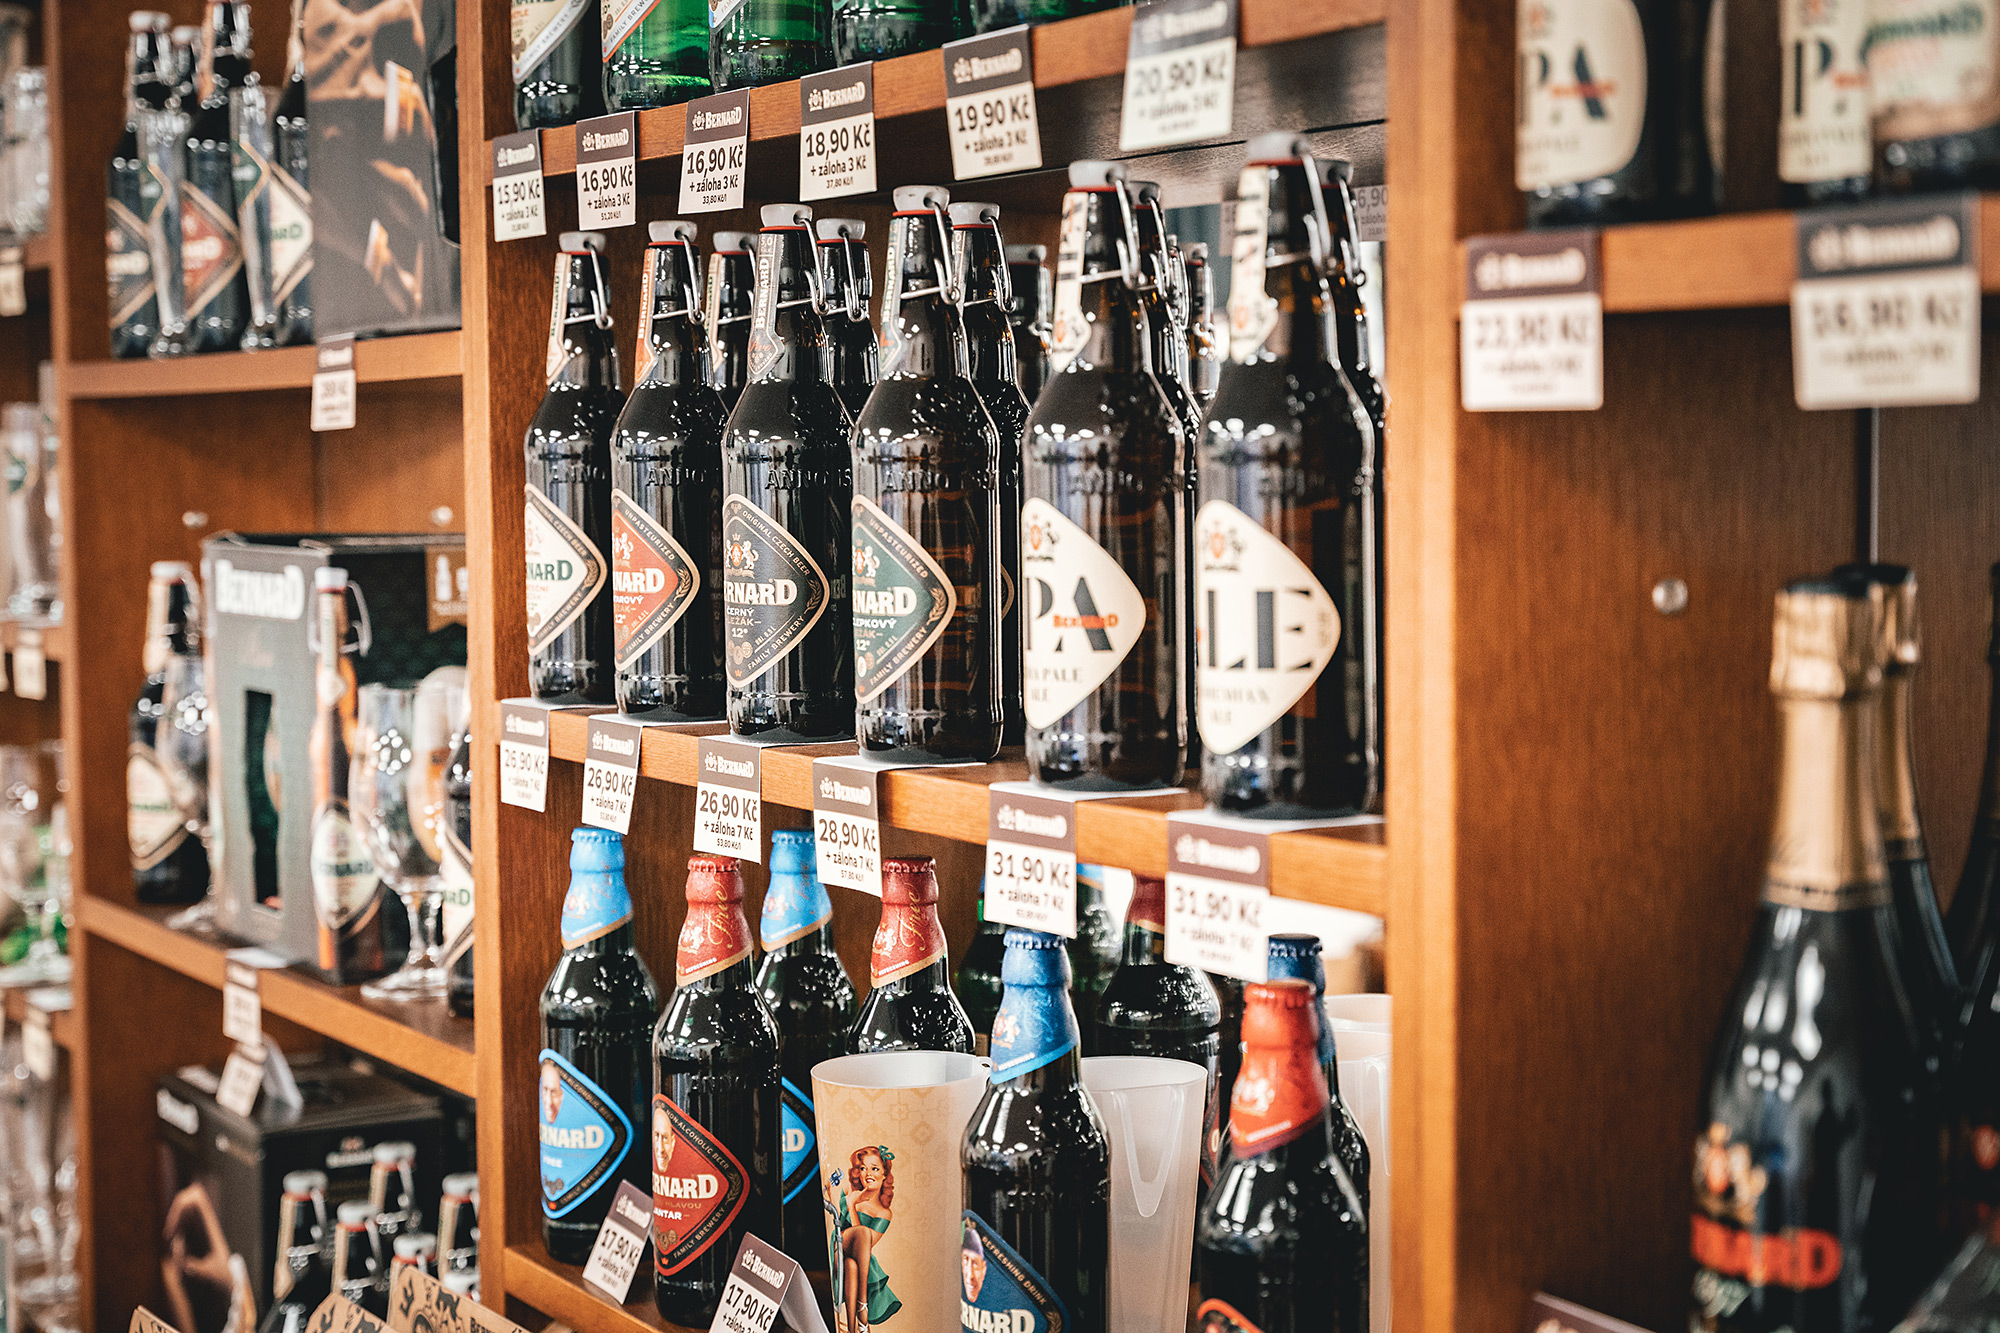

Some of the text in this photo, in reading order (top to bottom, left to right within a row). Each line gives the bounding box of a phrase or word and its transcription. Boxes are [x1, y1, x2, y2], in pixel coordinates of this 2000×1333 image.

[610, 21, 628, 43] FAMILY
[822, 81, 866, 109] BERNARD
[705, 106, 743, 130] BERNARD
[955, 94, 1031, 134] 19,90 Kč
[595, 128, 629, 151] BERNARD
[805, 122, 871, 160] 18,90 Kč
[687, 144, 743, 178] 16,90 Kč
[818, 155, 866, 177] záloha 3 Kč
[498, 179, 540, 207] 15,90 Kč
[581, 164, 633, 195] 16,90 Kč
[696, 174, 738, 192] záloha 3 Kč
[594, 193, 630, 210] záloha 3 Kč
[638, 273, 648, 339] BERNARD
[755, 258, 770, 329] BERNARD
[764, 469, 830, 491] ANNO
[624, 508, 675, 561] UNPASTEURIZED
[742, 510, 811, 576] ORIGINAL CZECH BEER
[869, 518, 929, 579] UNPASTEURIZED
[726, 606, 755, 617] ČERNÝ
[626, 602, 675, 654] FAMILY BREWERY
[732, 628, 749, 638] 12°
[747, 616, 805, 671] FAMILY BREWERY
[869, 626, 928, 686] FAMILY BREWERY
[504, 749, 545, 775] 26,90 Kč
[717, 756, 755, 779] BERNARD
[587, 767, 634, 797] 26,90 Kč
[833, 781, 872, 807] BERNARD
[595, 797, 615, 810] záloha
[700, 790, 758, 823] 26,90 Kč
[710, 821, 754, 841] záloha 7 Kč
[716, 838, 731, 849] 53,80
[818, 818, 877, 853] 28,90 Kč
[833, 853, 874, 873] záloha 7 Kč
[993, 851, 1070, 889] 31,90 Kč
[1174, 885, 1232, 923] 31,90
[665, 1109, 730, 1171] NON-ALCOHOLIC BEER
[602, 1229, 629, 1259] 17,90
[672, 1207, 726, 1259] FAMILY BREWERY
[752, 1255, 785, 1290] BERNARD
[982, 1236, 1047, 1305] REFRESHING DRINK
[725, 1284, 775, 1331] 17,90 Kč
